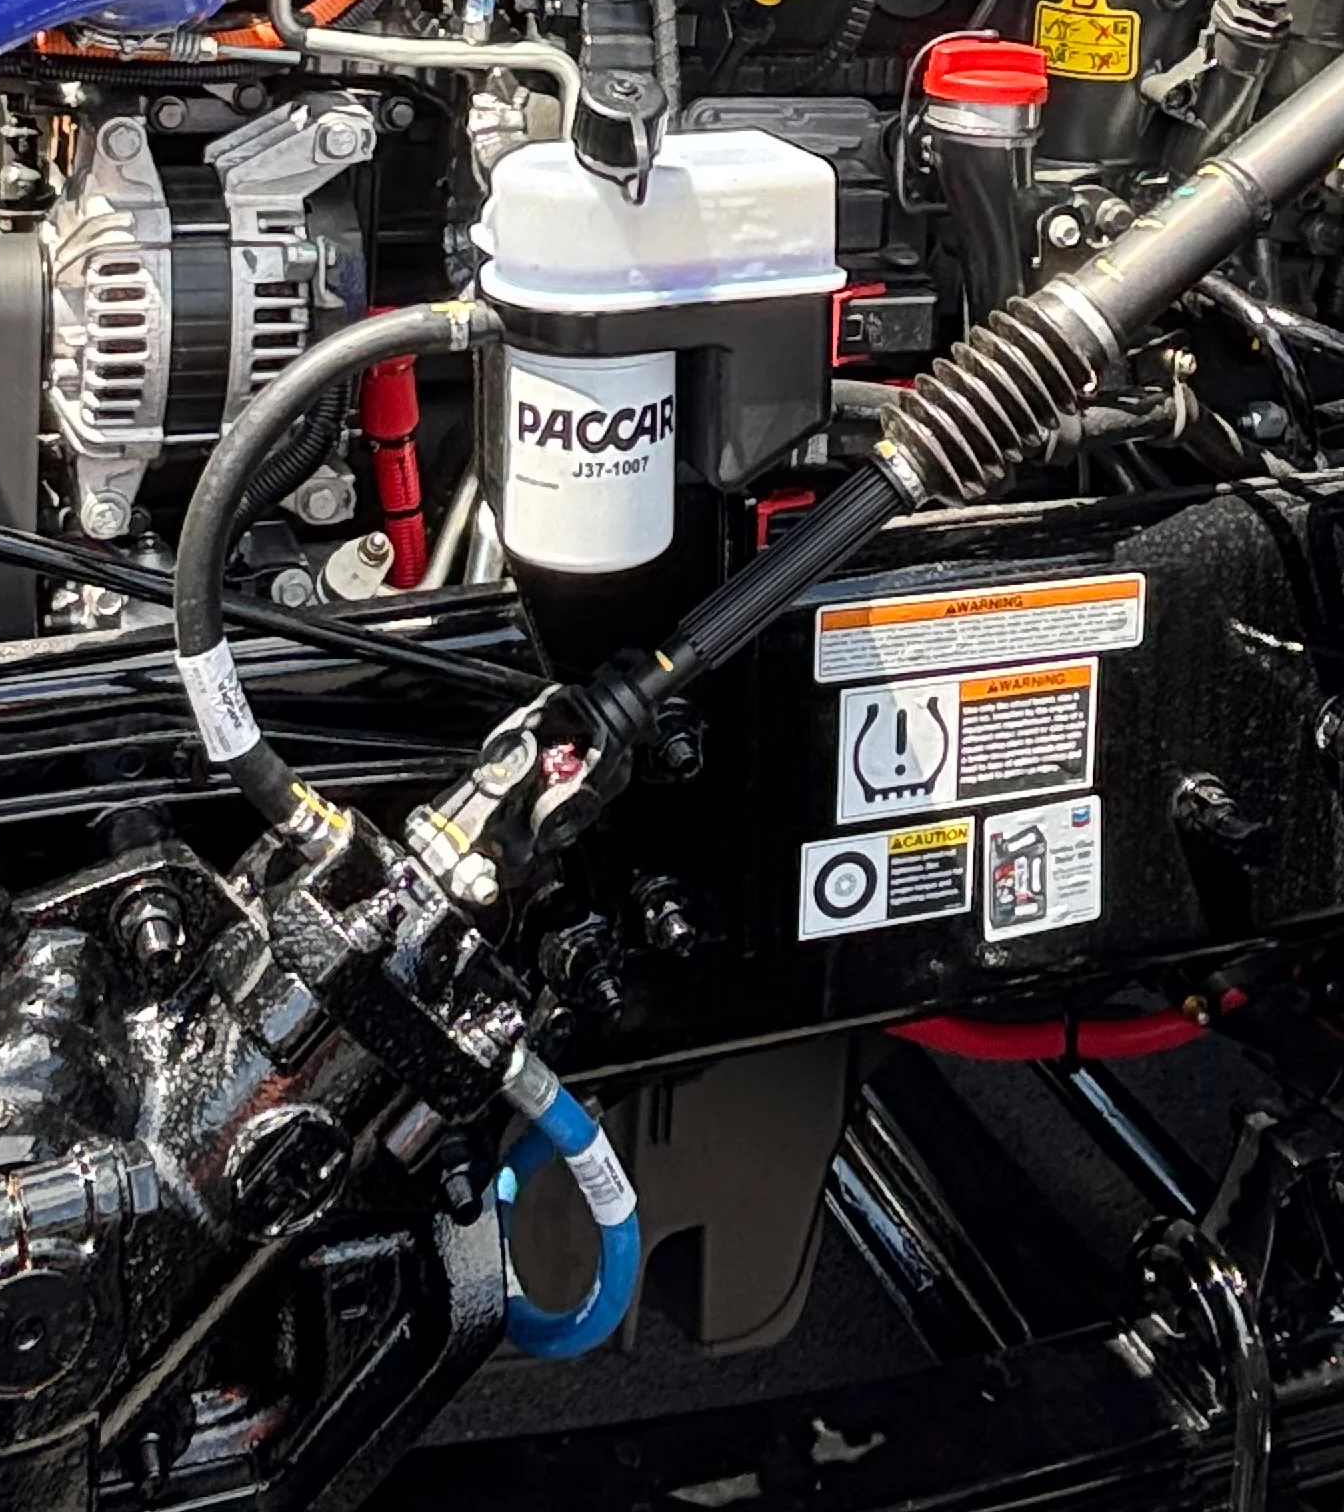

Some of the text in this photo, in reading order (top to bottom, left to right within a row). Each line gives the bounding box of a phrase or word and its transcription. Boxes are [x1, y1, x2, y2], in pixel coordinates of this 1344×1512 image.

[518, 395, 674, 453] PACCAR
[572, 455, 650, 479] J37-1007
[956, 595, 1024, 614] WARNING
[998, 672, 1067, 692] WARNING
[902, 828, 968, 848] CAUTION
